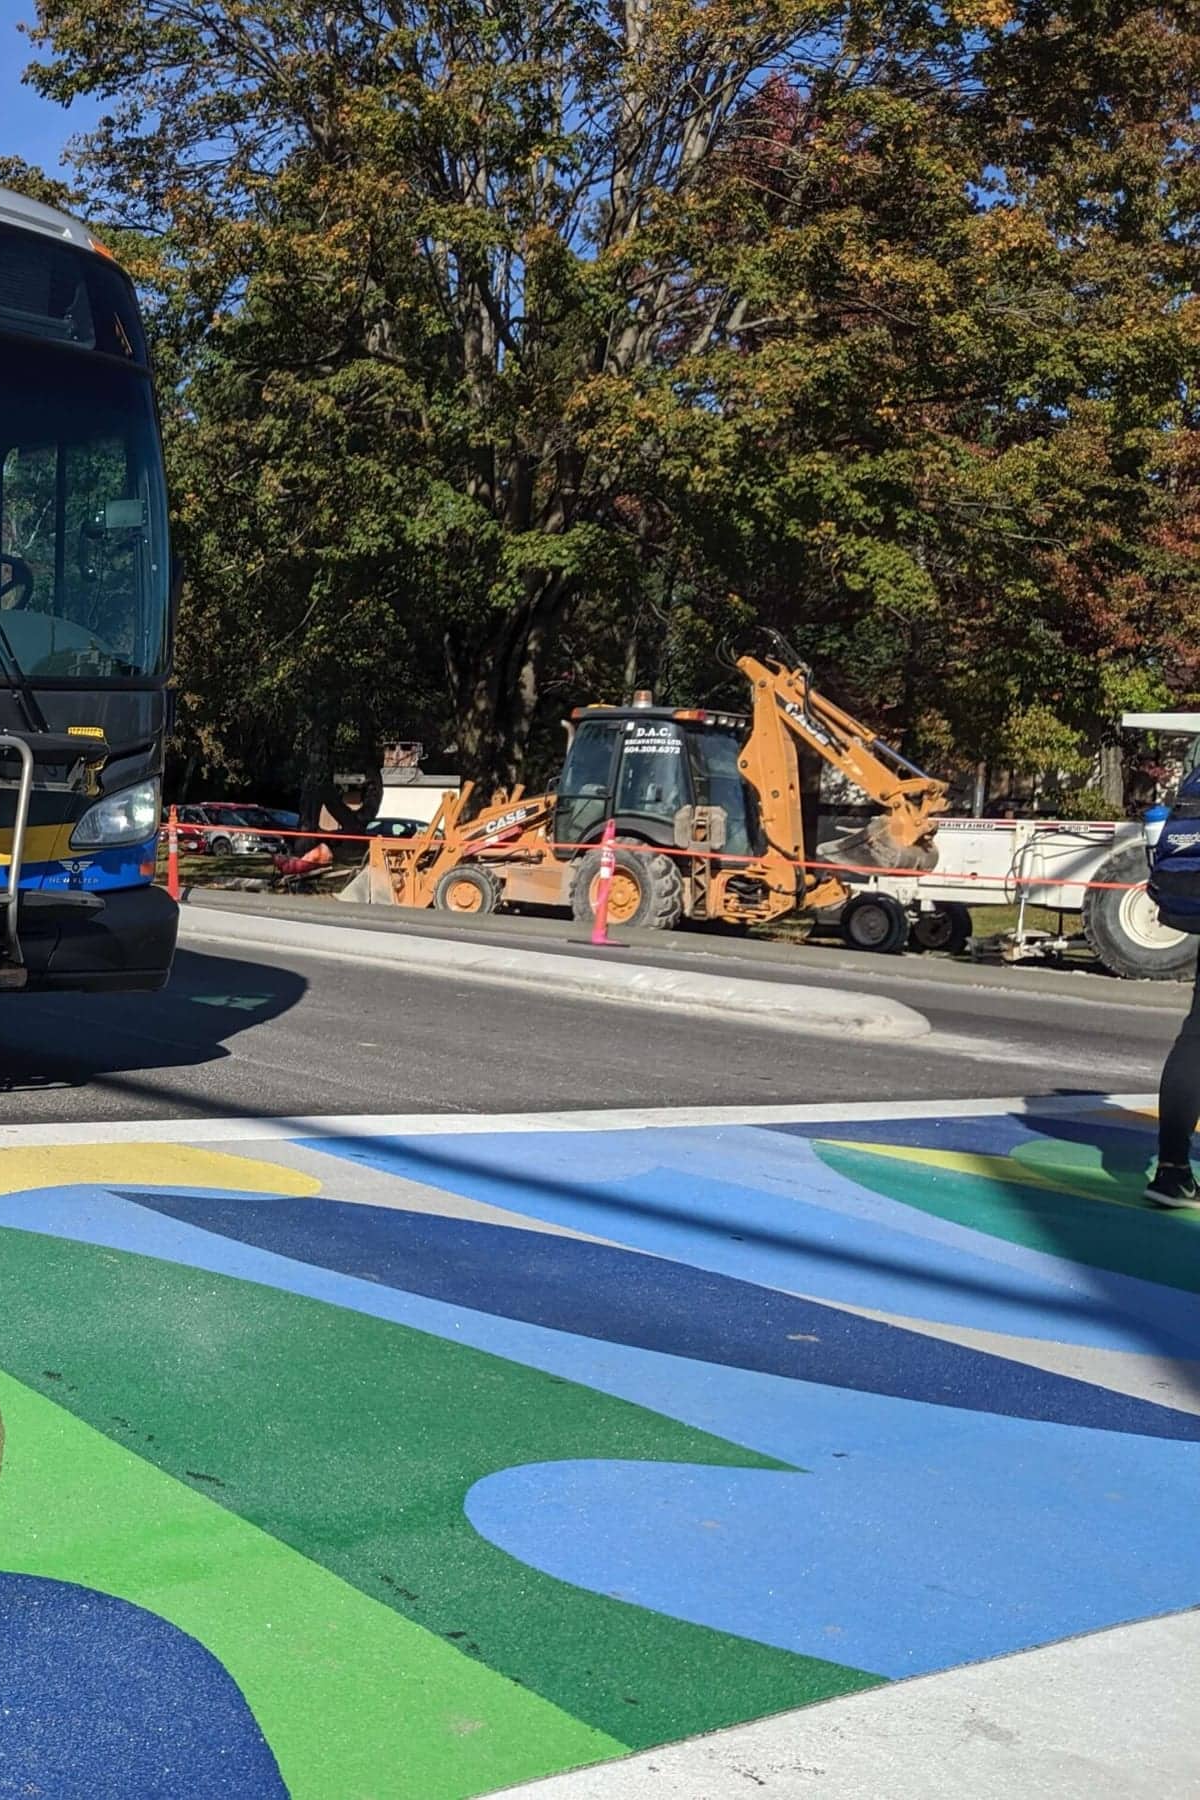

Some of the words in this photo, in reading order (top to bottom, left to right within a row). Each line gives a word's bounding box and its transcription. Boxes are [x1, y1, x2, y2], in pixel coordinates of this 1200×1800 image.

[636, 727, 673, 737] D.A.C.
[485, 807, 527, 834] CASE
[1167, 832, 1200, 846] speed
